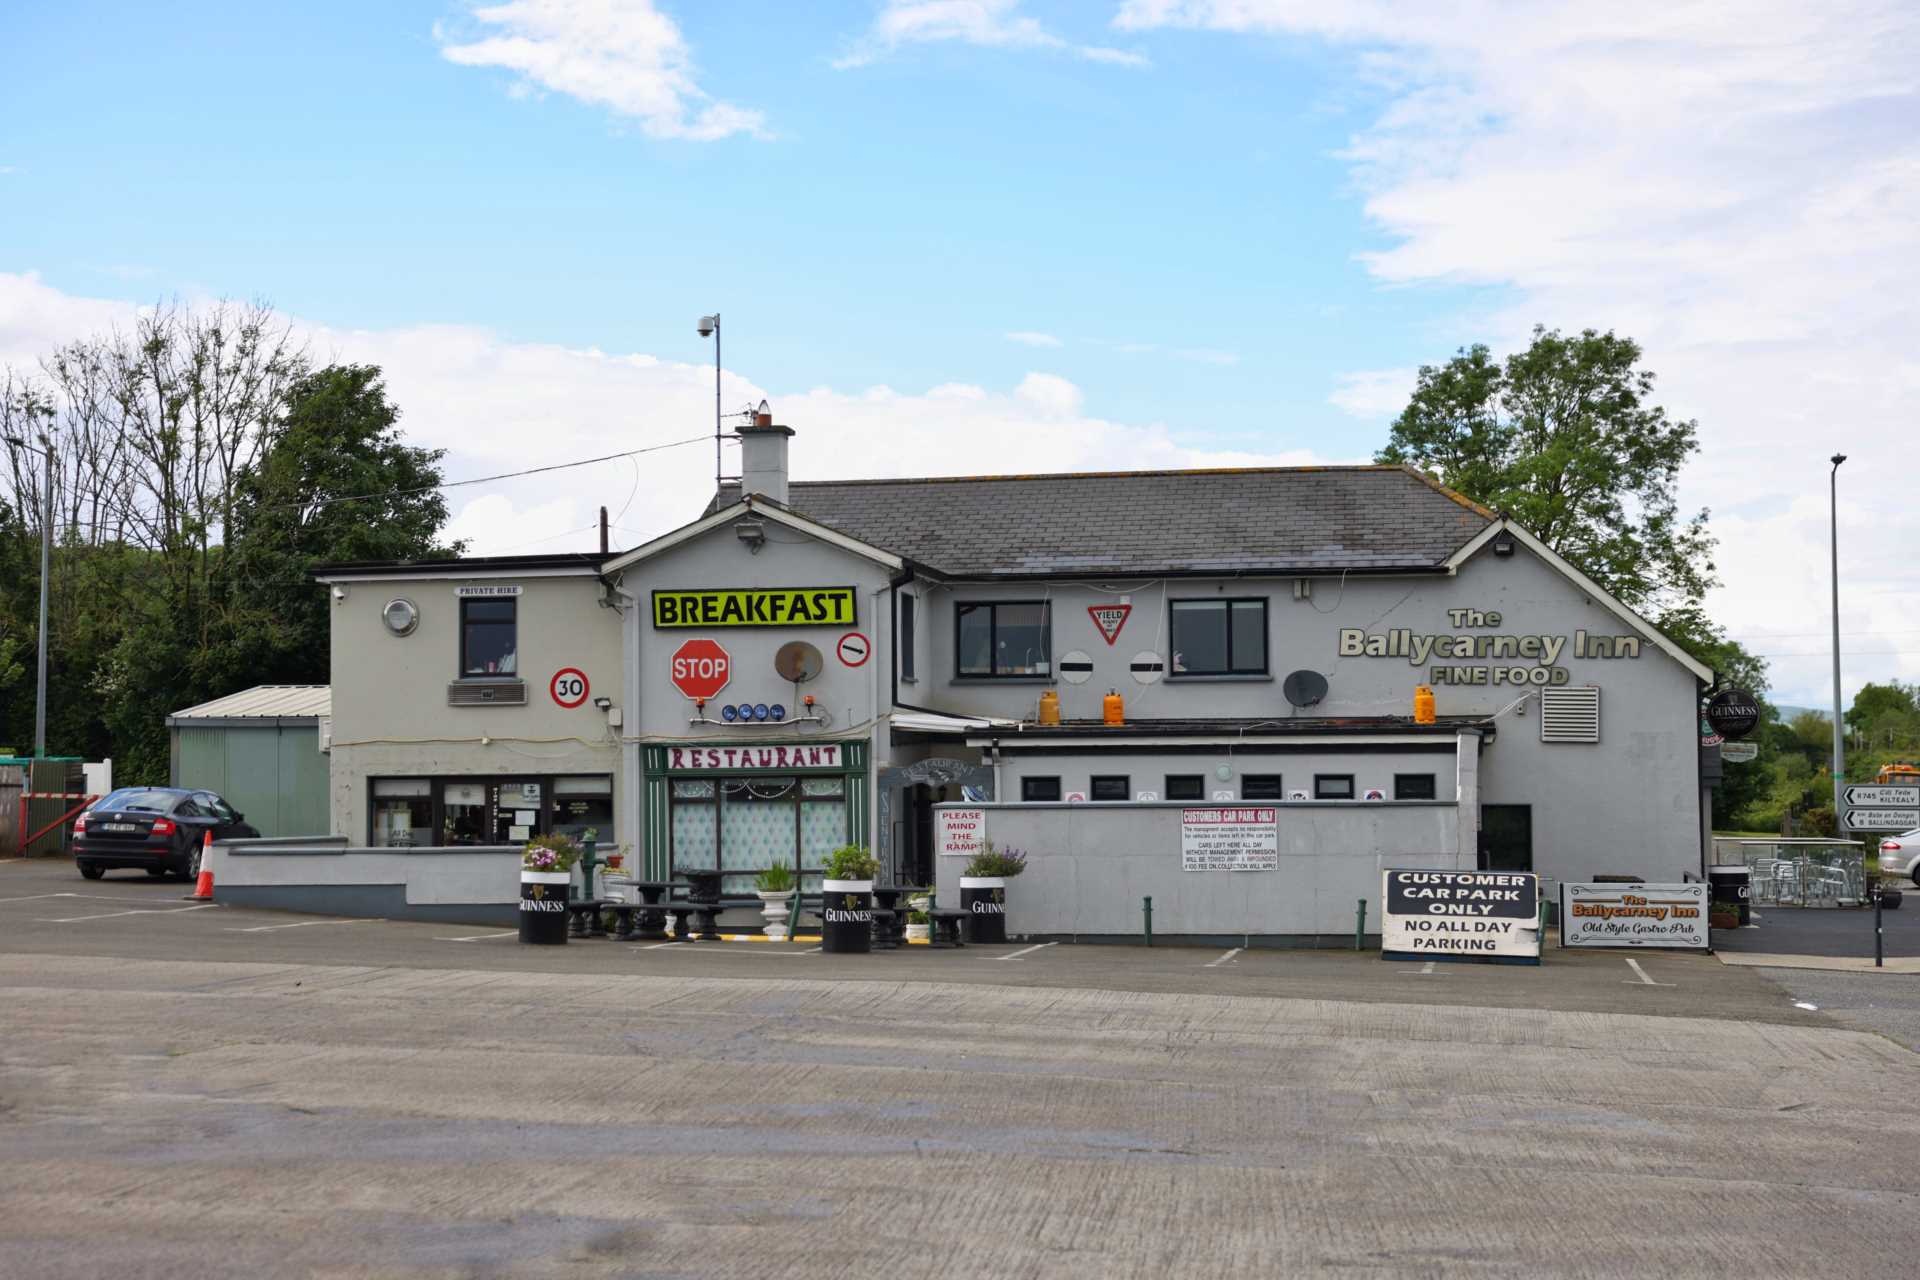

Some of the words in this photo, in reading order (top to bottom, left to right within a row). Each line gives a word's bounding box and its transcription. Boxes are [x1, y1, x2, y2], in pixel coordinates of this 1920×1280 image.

[659, 593, 848, 624] BREAKFAST
[1096, 610, 1122, 619] YIELD
[1448, 608, 1502, 628] The
[1338, 628, 1566, 666] Ballycarney
[1573, 630, 1642, 659] Inn
[674, 658, 727, 680] STOP
[1430, 665, 1488, 686] FINE
[1492, 666, 1570, 686] FOOD
[558, 679, 583, 696] 30
[1711, 705, 1758, 716] GUINNESS
[671, 747, 837, 769] RESTAURANT
[1184, 810, 1221, 822] CUSTOMERS
[1223, 810, 1237, 822] CAR
[1238, 810, 1255, 822] PARK
[1257, 810, 1274, 822] ONLY
[1397, 873, 1526, 886] CUSTOMER
[1403, 888, 1449, 899] CAR
[1456, 889, 1520, 901] PARK
[1621, 895, 1647, 906] The
[825, 908, 872, 922] GUINNESS
[1428, 903, 1494, 916] ONLY
[1572, 904, 1668, 920] Ballycarney
[1670, 904, 1699, 918] Inn
[1405, 920, 1431, 931] NO
[1436, 921, 1470, 933] ALL
[1474, 922, 1512, 933] DAY
[1582, 921, 1602, 933] Old
[1604, 922, 1630, 936] Style
[1632, 922, 1667, 935] Gastro
[1669, 923, 1694, 933] Pub
[1413, 938, 1497, 951] PARKING
